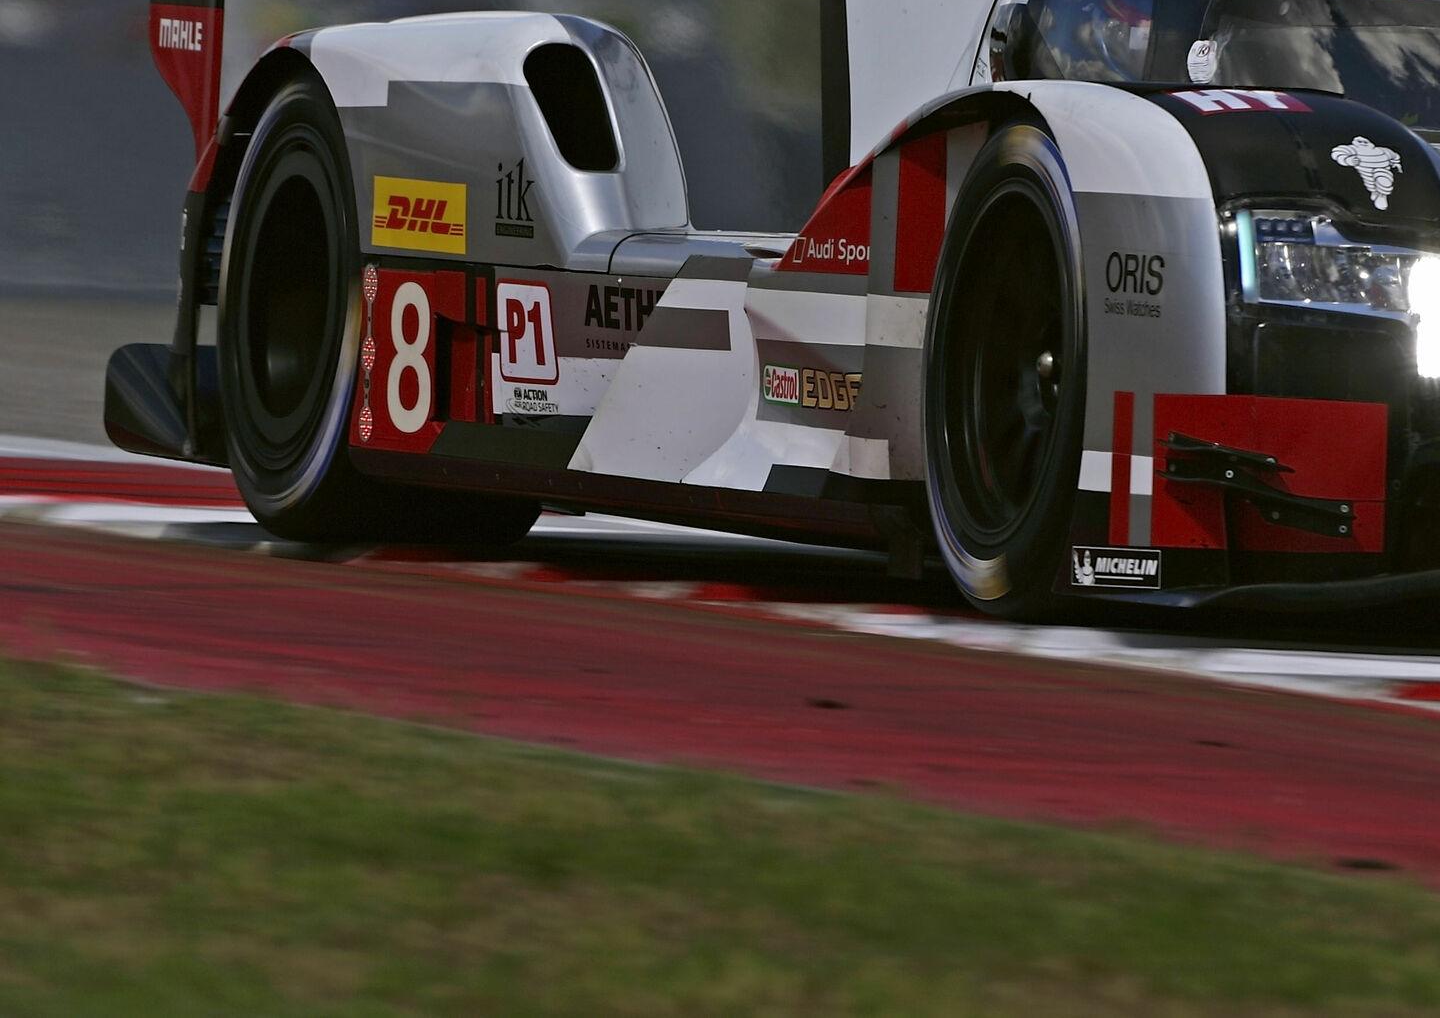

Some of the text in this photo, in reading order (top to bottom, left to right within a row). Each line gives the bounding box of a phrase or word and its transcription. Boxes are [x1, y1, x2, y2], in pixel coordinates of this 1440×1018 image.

[159, 18, 203, 51] MAHLE
[1171, 89, 1289, 112] HY
[495, 158, 535, 222] itk
[386, 195, 451, 235] DHL
[807, 237, 834, 260] Audi
[1106, 251, 1165, 296] ORIS
[1104, 297, 1161, 318] Swiss Watches
[505, 298, 547, 366] P1
[387, 281, 431, 433] 8
[523, 388, 548, 401] ACTION
[771, 368, 798, 400] Castrol
[522, 401, 538, 412] ROAD
[538, 402, 559, 413] SAFETY
[1095, 557, 1158, 576] MICHELIN
